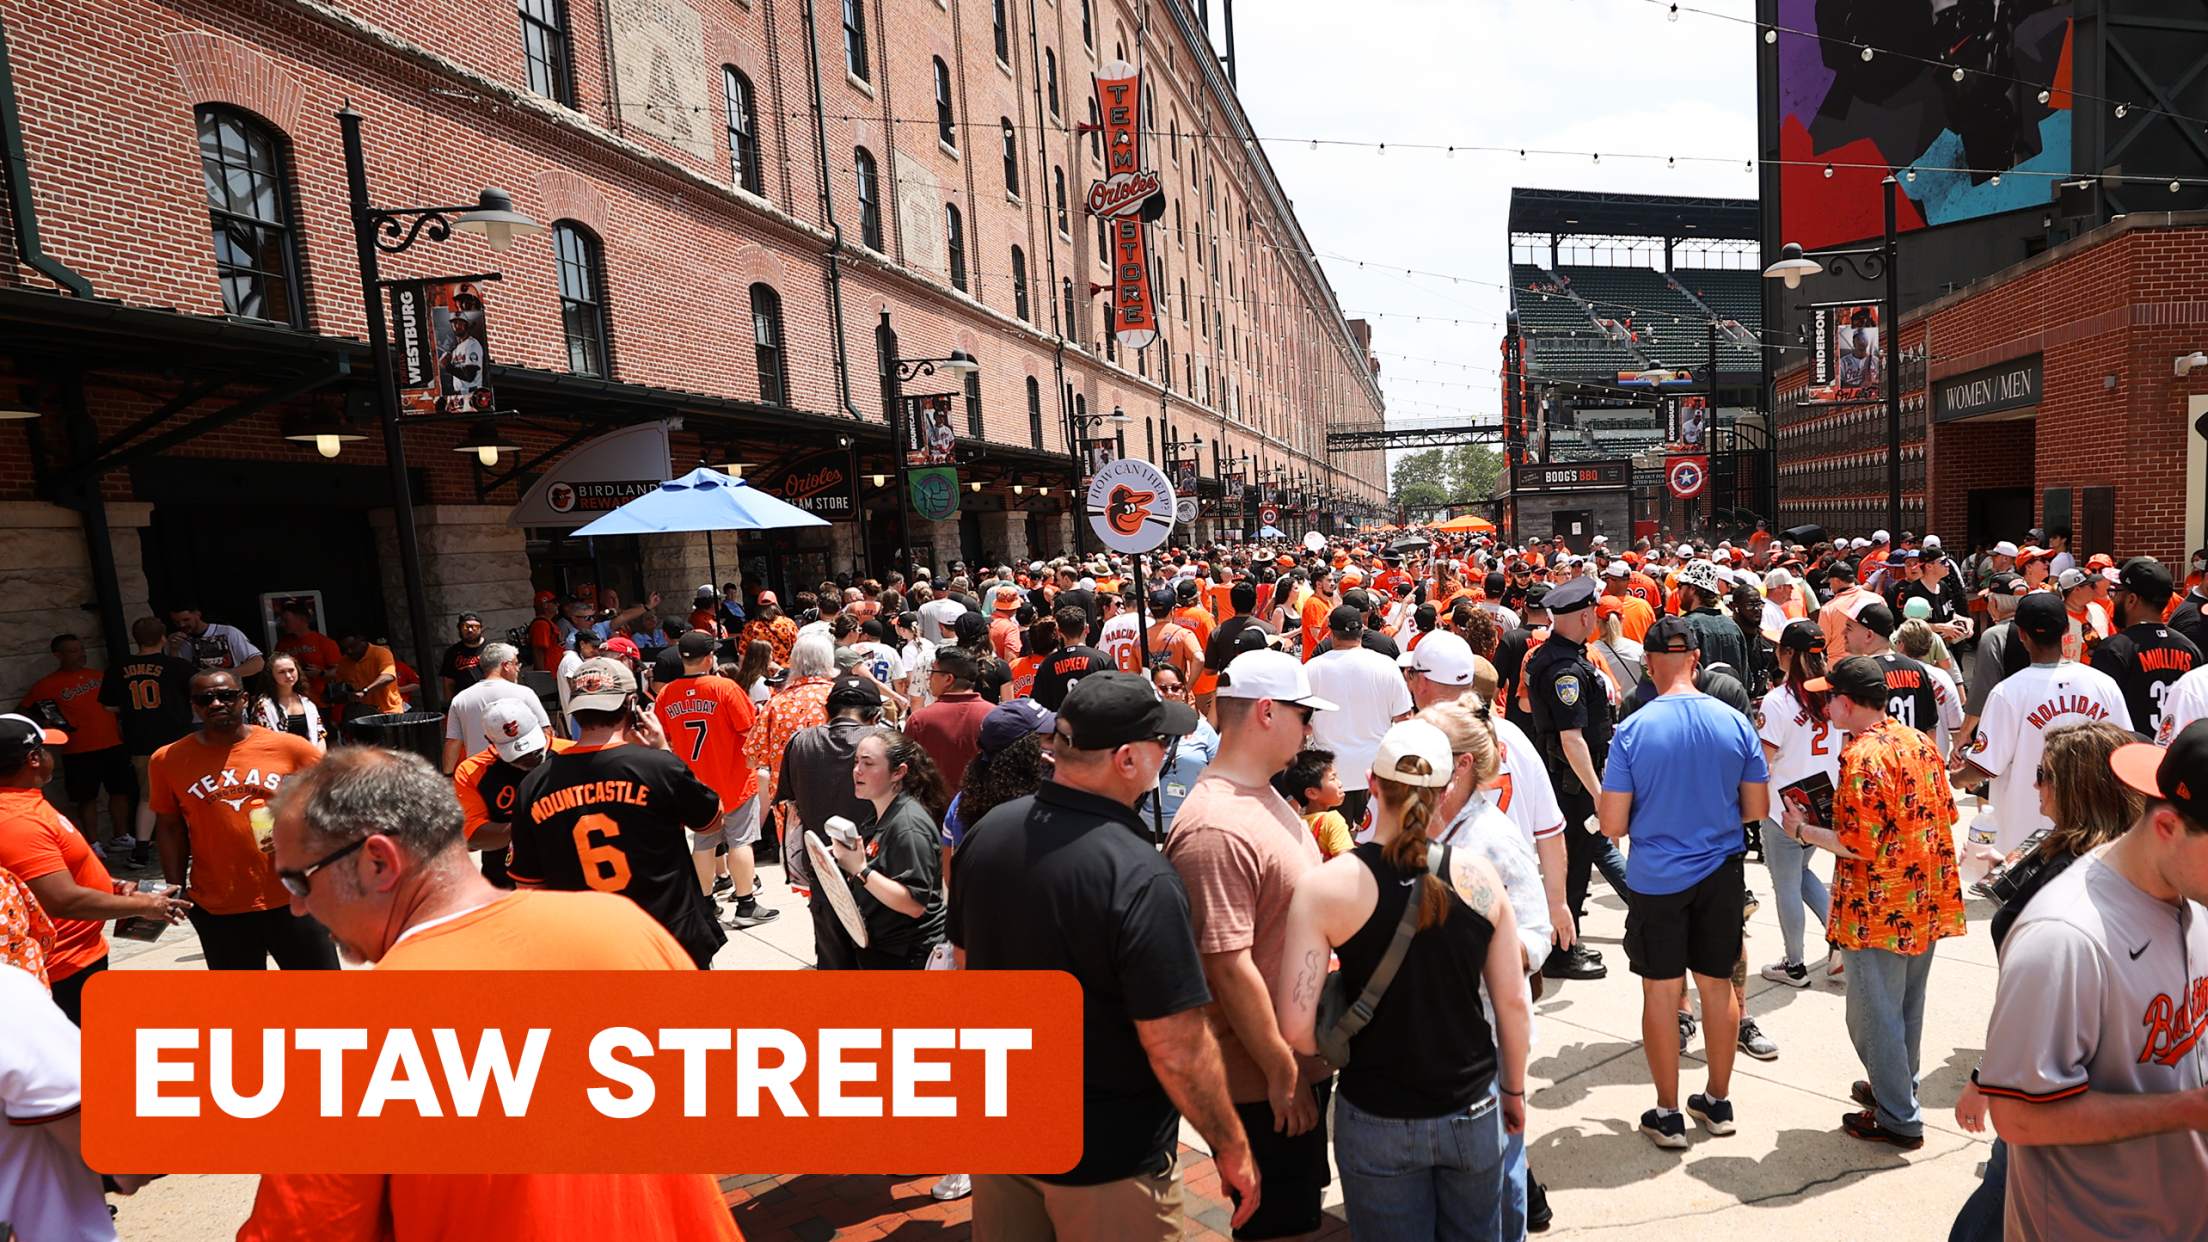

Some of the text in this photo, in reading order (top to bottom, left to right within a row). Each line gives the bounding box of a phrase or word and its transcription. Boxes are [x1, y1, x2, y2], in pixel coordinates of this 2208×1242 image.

[1107, 85, 1132, 168] TEAM
[1090, 173, 1160, 213] Orioles
[1120, 221, 1145, 323] STORE
[401, 290, 421, 385] WESTBURG
[1816, 310, 1826, 383] HENDERSON
[1946, 378, 1992, 411] WOMEN
[2001, 368, 2032, 401] MEN
[907, 398, 918, 450] MOUNTCASTLE
[579, 484, 659, 498] BIRDLAND
[785, 467, 843, 500] Orioles
[1091, 469, 1113, 499] HOW
[1114, 463, 1140, 476] CAN
[1147, 473, 1170, 510] HELP?
[1545, 470, 1577, 482] BOOG'S
[1580, 470, 1598, 481] BBQ
[816, 496, 849, 510] STORE
[123, 664, 164, 679] JONES
[1054, 656, 1090, 676] RIPKEN
[2138, 648, 2192, 673] MULLINS
[61, 678, 103, 701] Oriole
[129, 679, 162, 710] 10
[2149, 680, 2177, 731] 3
[665, 699, 718, 720] HOLLIDAY
[2026, 694, 2109, 730] HOLLIDAY
[683, 718, 708, 761] 7
[1811, 722, 1829, 756] 2
[187, 768, 282, 800] TEXAS
[206, 786, 265, 806] LONGHORNS
[530, 780, 650, 826] MOUNTCASTLE
[572, 813, 632, 892] 6
